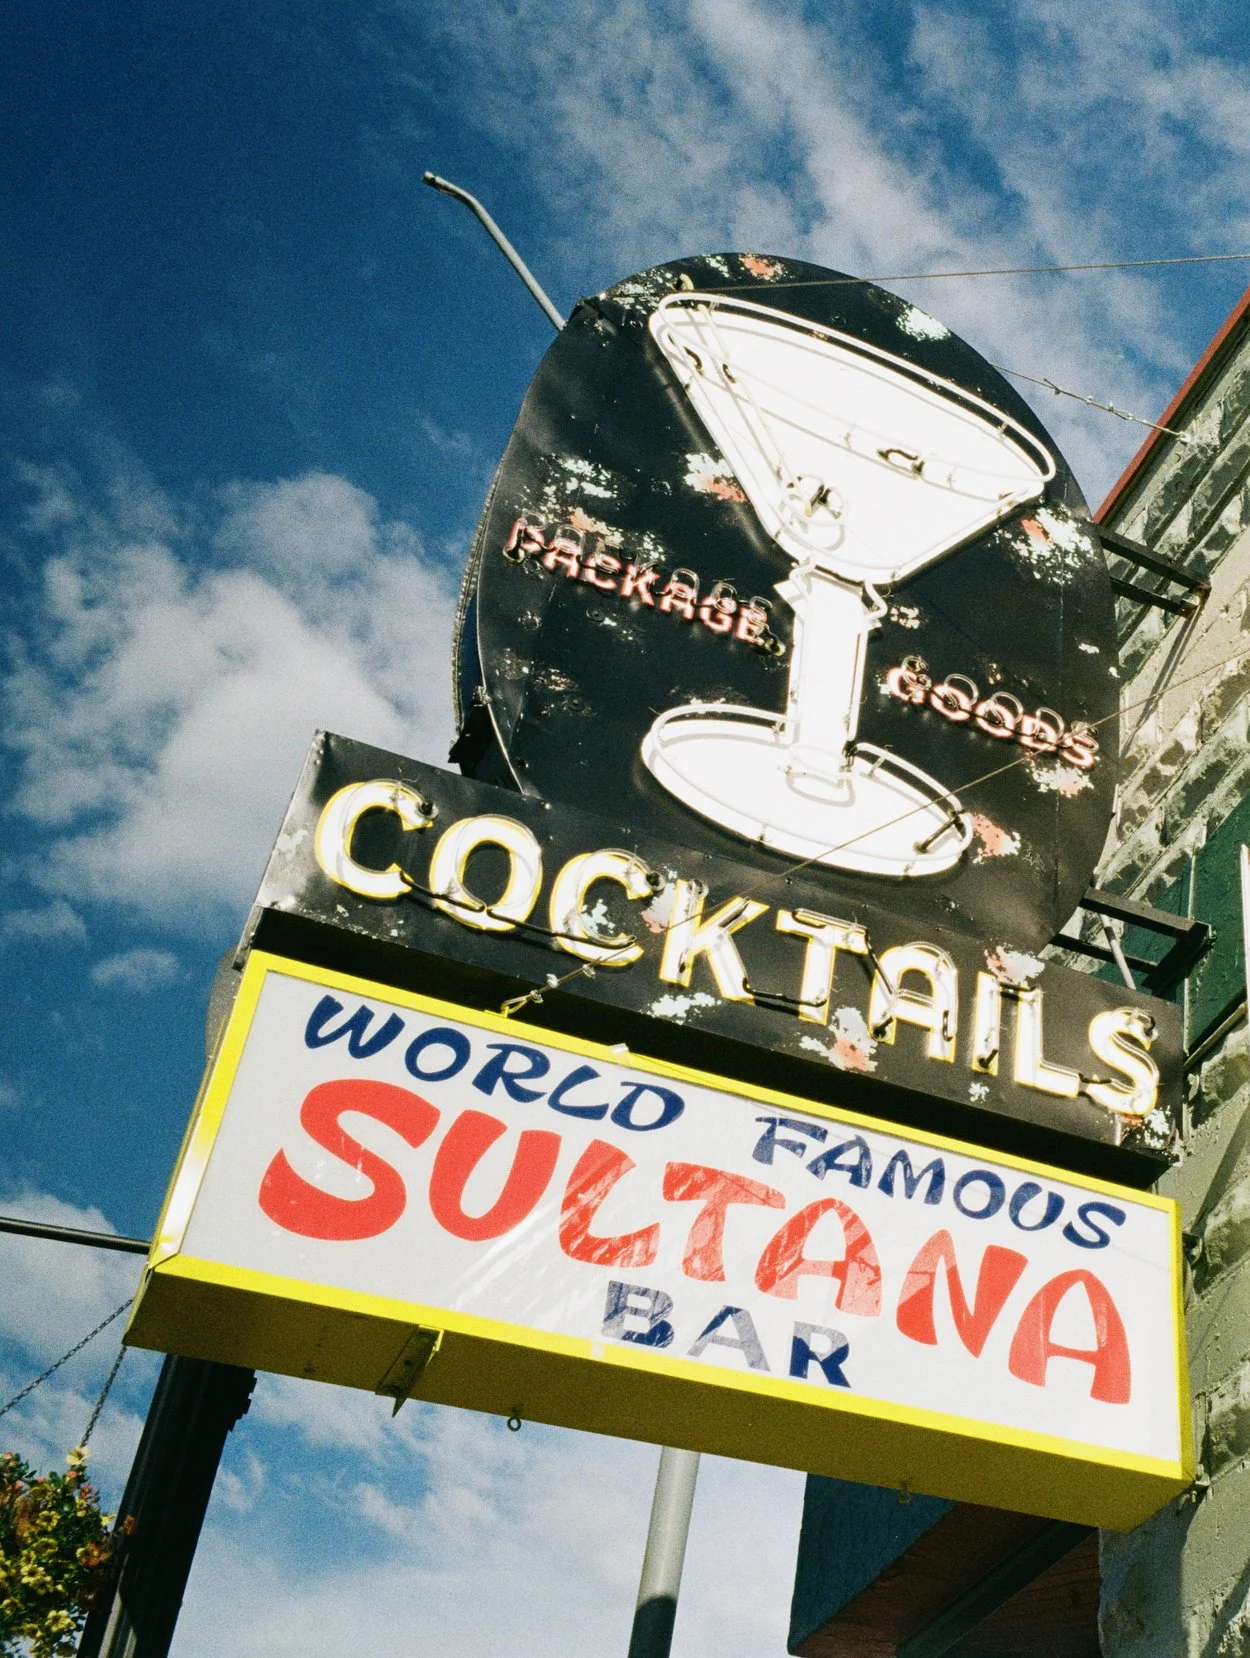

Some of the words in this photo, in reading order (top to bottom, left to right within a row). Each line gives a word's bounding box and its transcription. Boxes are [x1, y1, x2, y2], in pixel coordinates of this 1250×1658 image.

[506, 512, 773, 647] PACKAGE
[886, 658, 1098, 769] GOODS
[313, 778, 1161, 1118] COCKTAILS
[257, 1077, 1132, 1405] SULTANA
[303, 994, 686, 1132] WORLD
[751, 1116, 1127, 1251] FAMOUS
[601, 1279, 852, 1389] BAR
